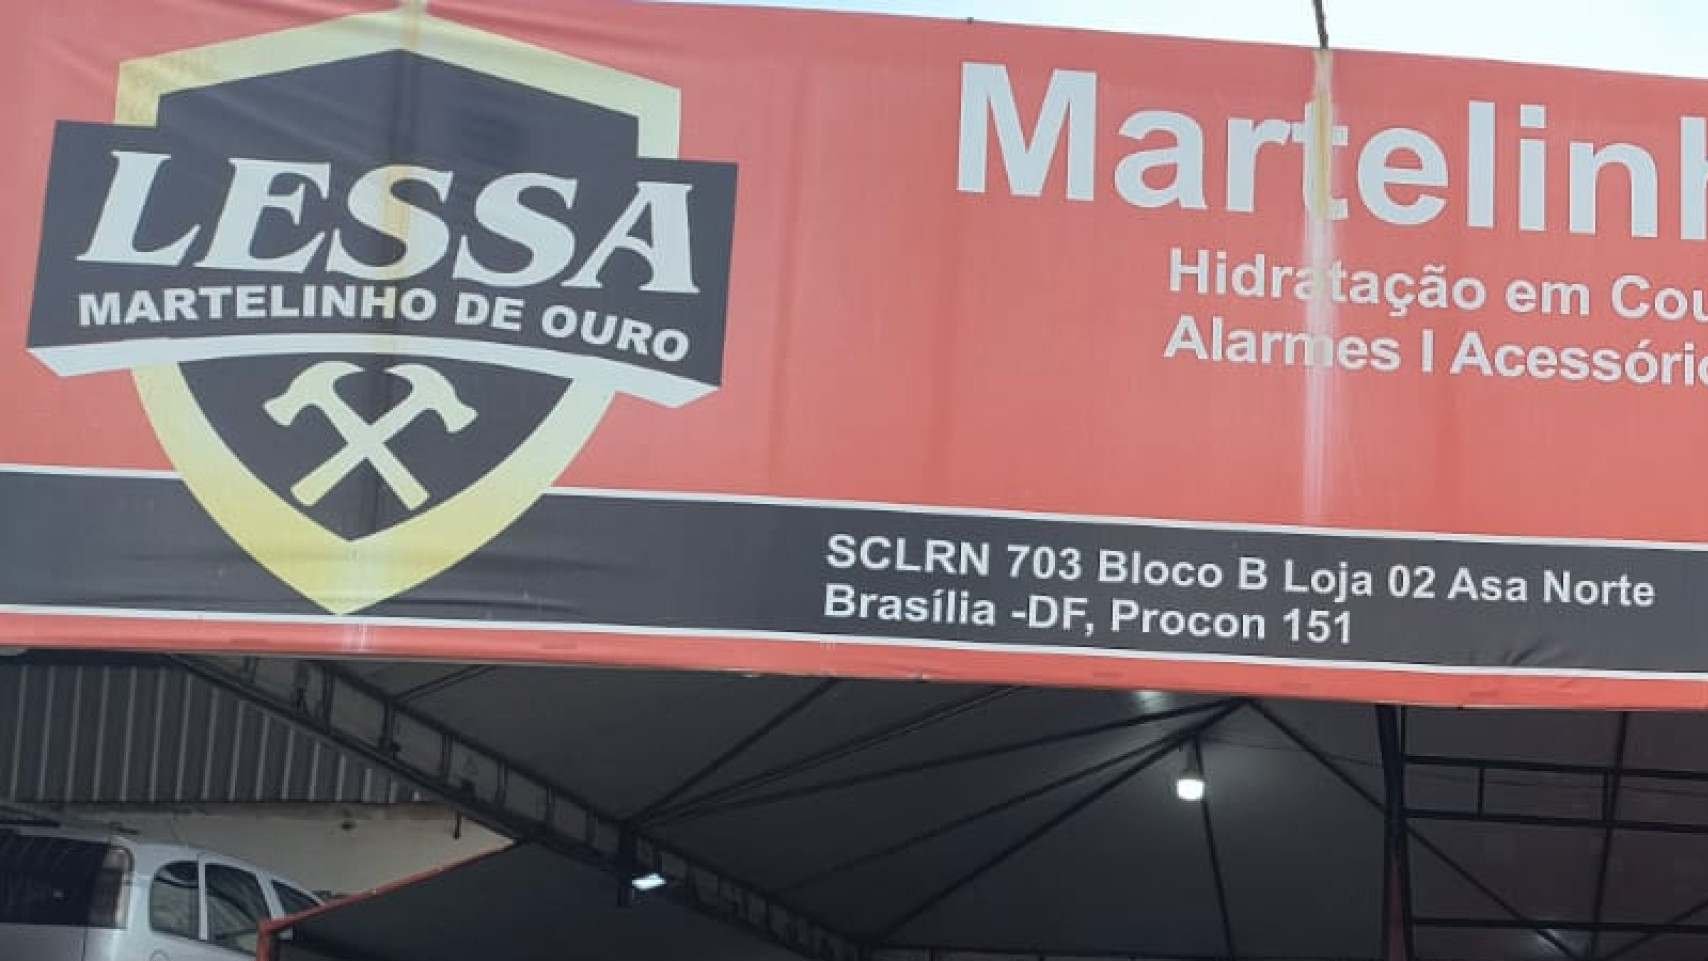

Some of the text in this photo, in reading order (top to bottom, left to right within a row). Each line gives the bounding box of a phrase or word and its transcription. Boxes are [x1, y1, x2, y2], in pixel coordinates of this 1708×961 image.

[77, 150, 699, 294] LESSA
[1170, 247, 1486, 312] Hidratação
[1506, 280, 1589, 315] em
[79, 285, 688, 363] MARTELINHO DE OURO
[1164, 315, 1401, 370] Alarmes
[827, 534, 1655, 606] SCLRN 703 Bloco B Loja 02 Asa Norte
[825, 583, 995, 626] Brasília
[1112, 599, 1264, 639] Procon
[1284, 608, 1350, 643] 151
